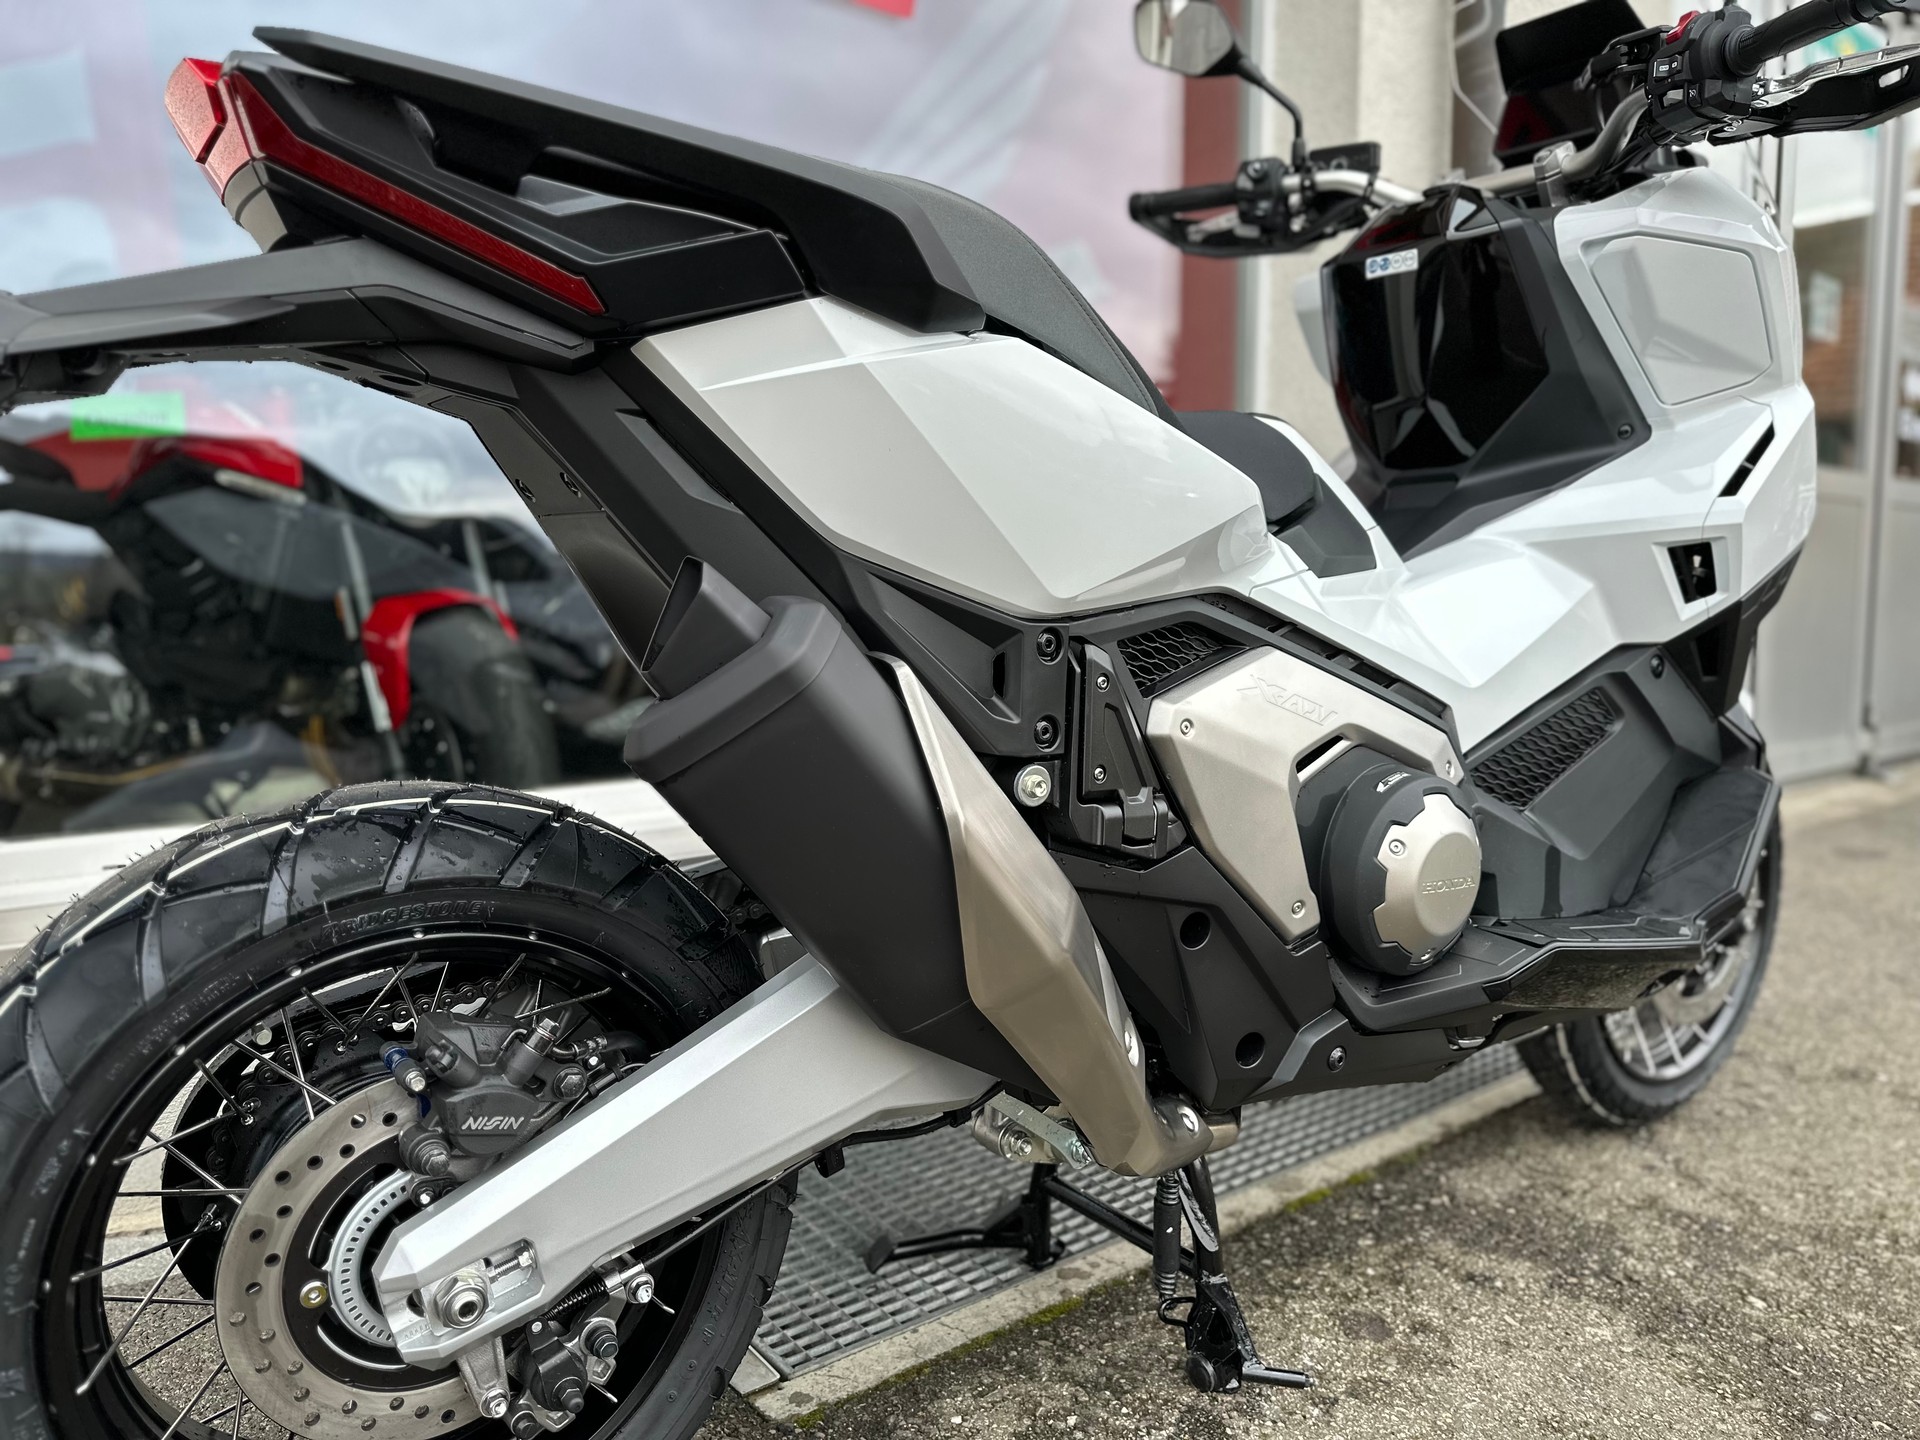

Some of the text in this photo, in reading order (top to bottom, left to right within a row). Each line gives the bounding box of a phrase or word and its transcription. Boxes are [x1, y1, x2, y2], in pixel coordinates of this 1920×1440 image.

[1236, 673, 1338, 727] X-ADV
[1421, 876, 1476, 894] HONDA
[321, 899, 485, 940] BRIDGESTONE
[461, 1116, 524, 1131] NISSIN
